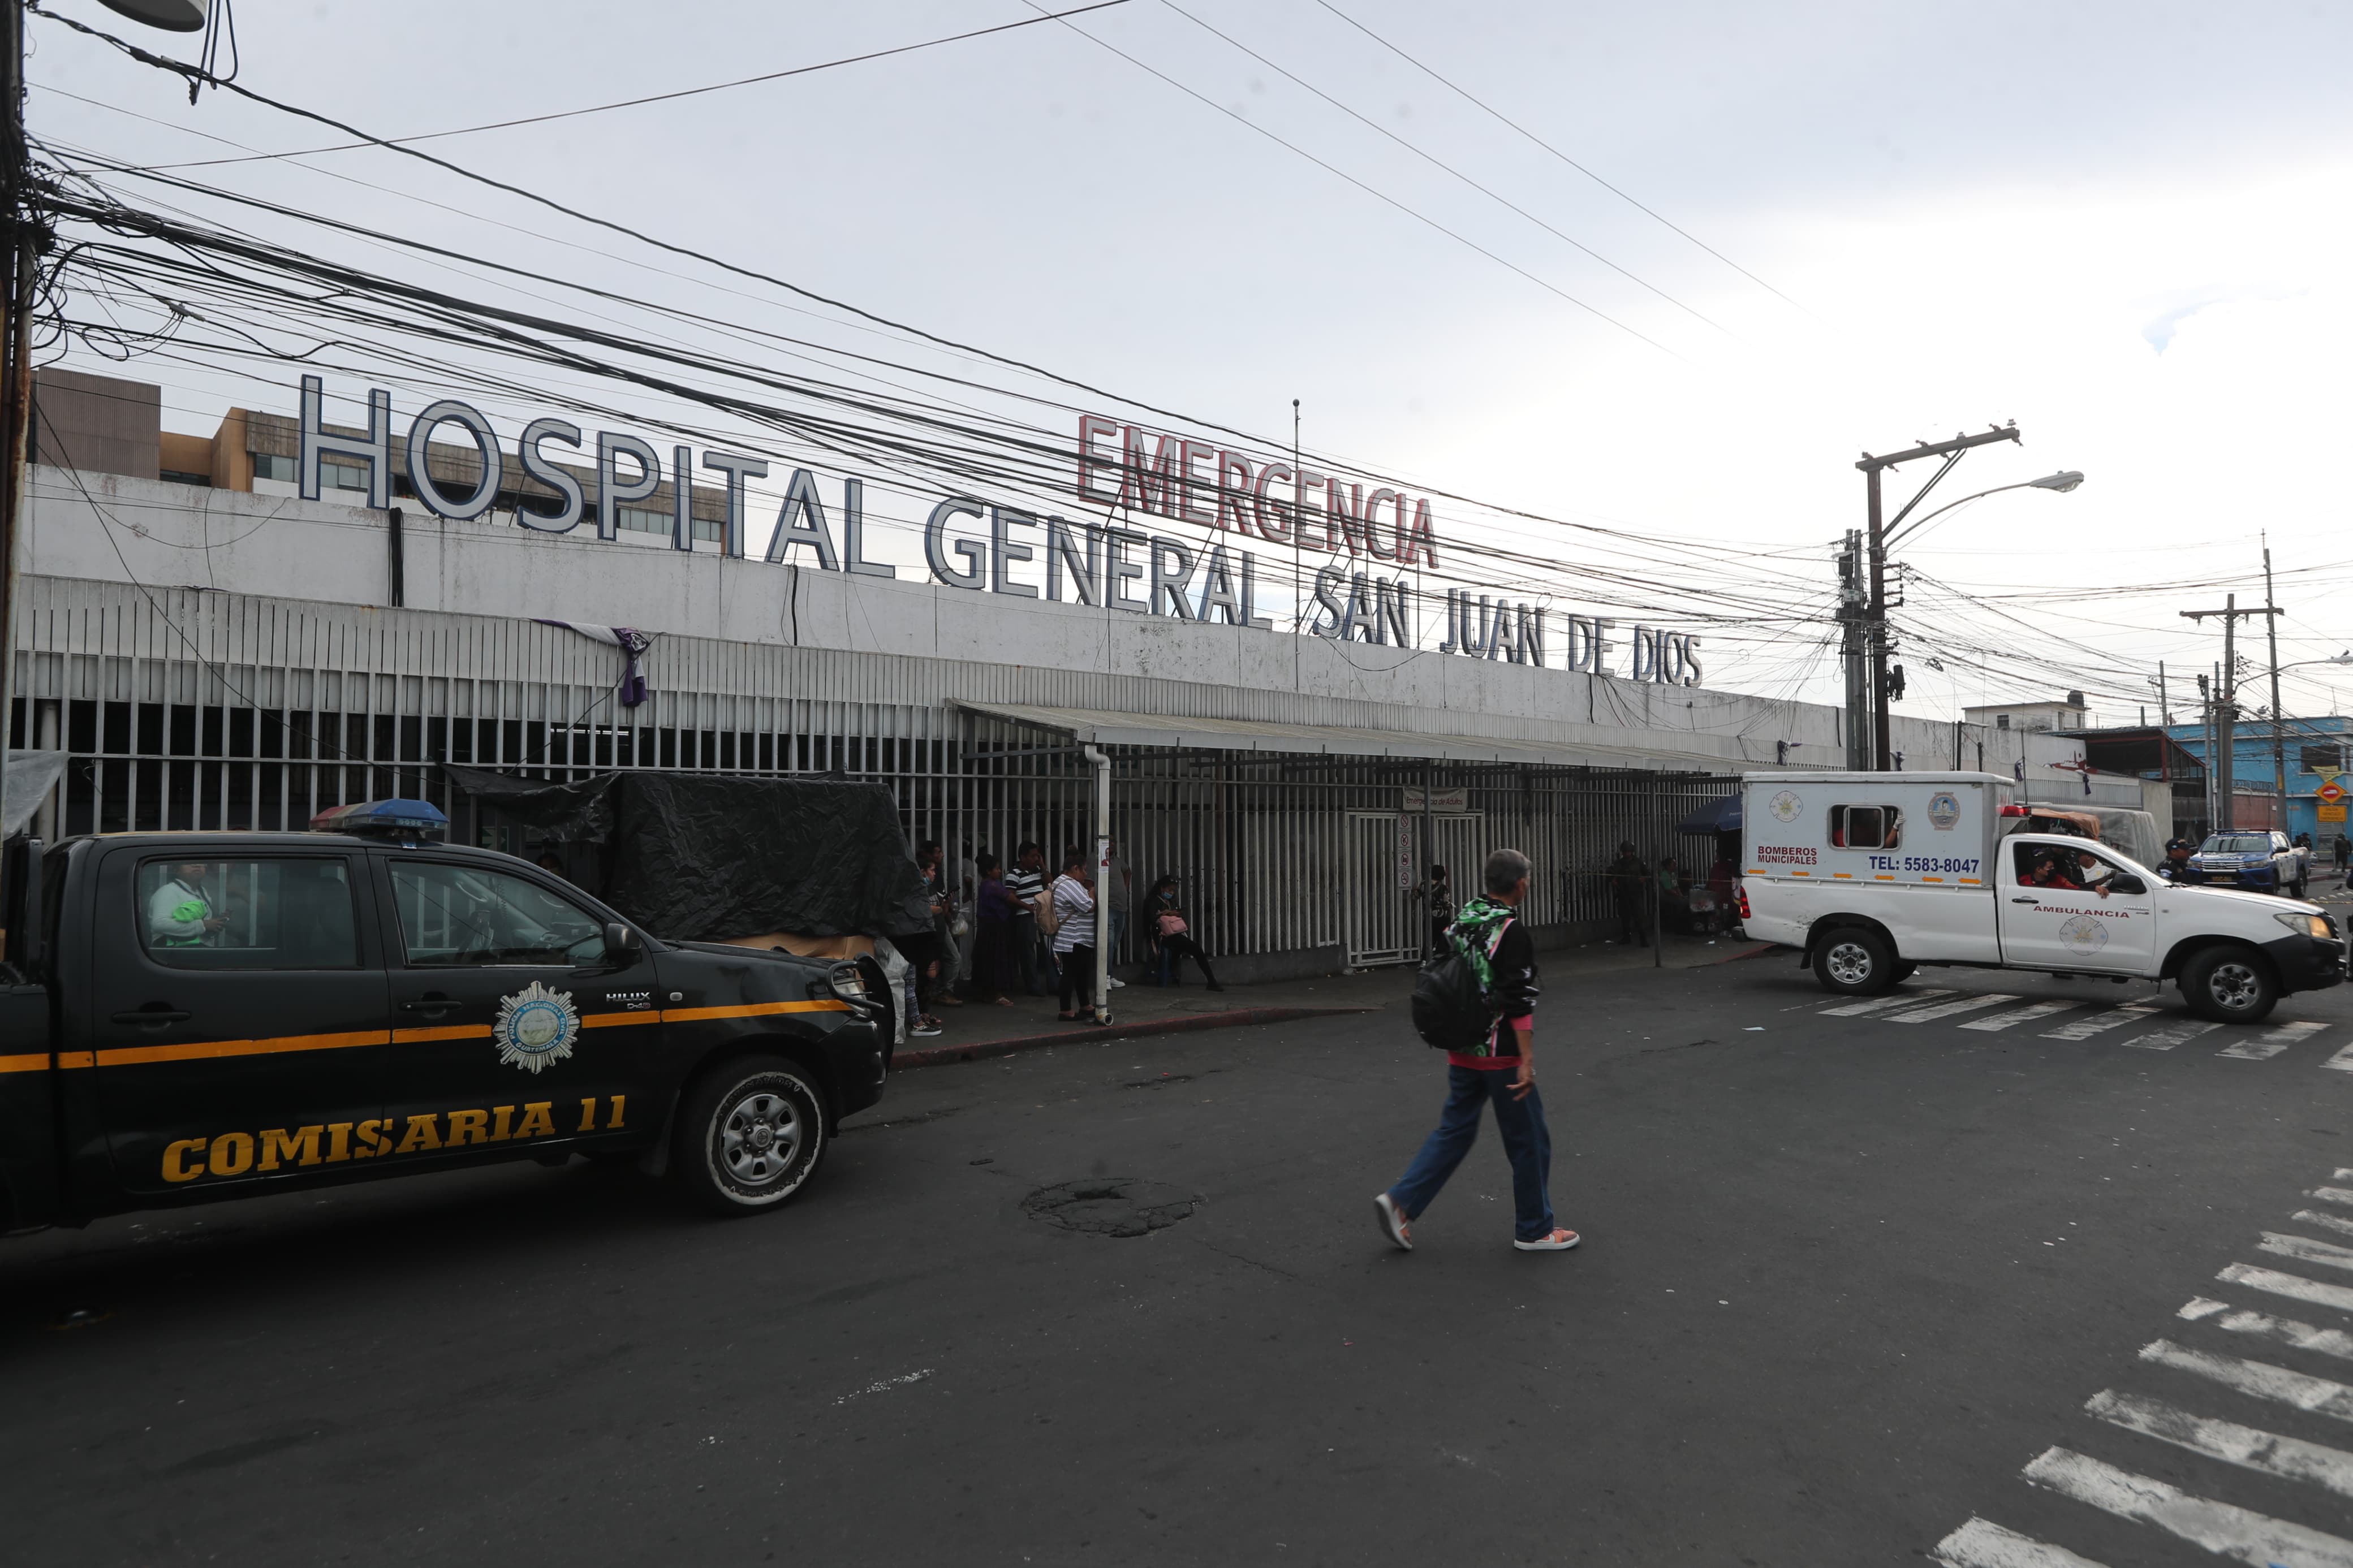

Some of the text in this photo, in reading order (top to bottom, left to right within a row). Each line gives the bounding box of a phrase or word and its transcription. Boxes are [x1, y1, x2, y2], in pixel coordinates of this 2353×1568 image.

[1078, 414, 1440, 568] EMERGENCIA
[299, 373, 1703, 688] HOSPITAL GENERAL SAN JUAN DE DIOS
[1406, 796, 1437, 806] Emergecia
[1758, 846, 1817, 856] BOMBEROS
[1757, 855, 1817, 865] MUNICIPALES
[1869, 856, 1979, 873] TEL: 5583-8047
[2033, 906, 2130, 918] AMBULANCIA
[606, 992, 650, 1002] HILUX
[508, 1010, 522, 1040] POLICIA
[523, 1002, 562, 1016] NACIONAL
[515, 1039, 559, 1052] GUATEMALA
[162, 1095, 625, 1182] COMISARIA 11
